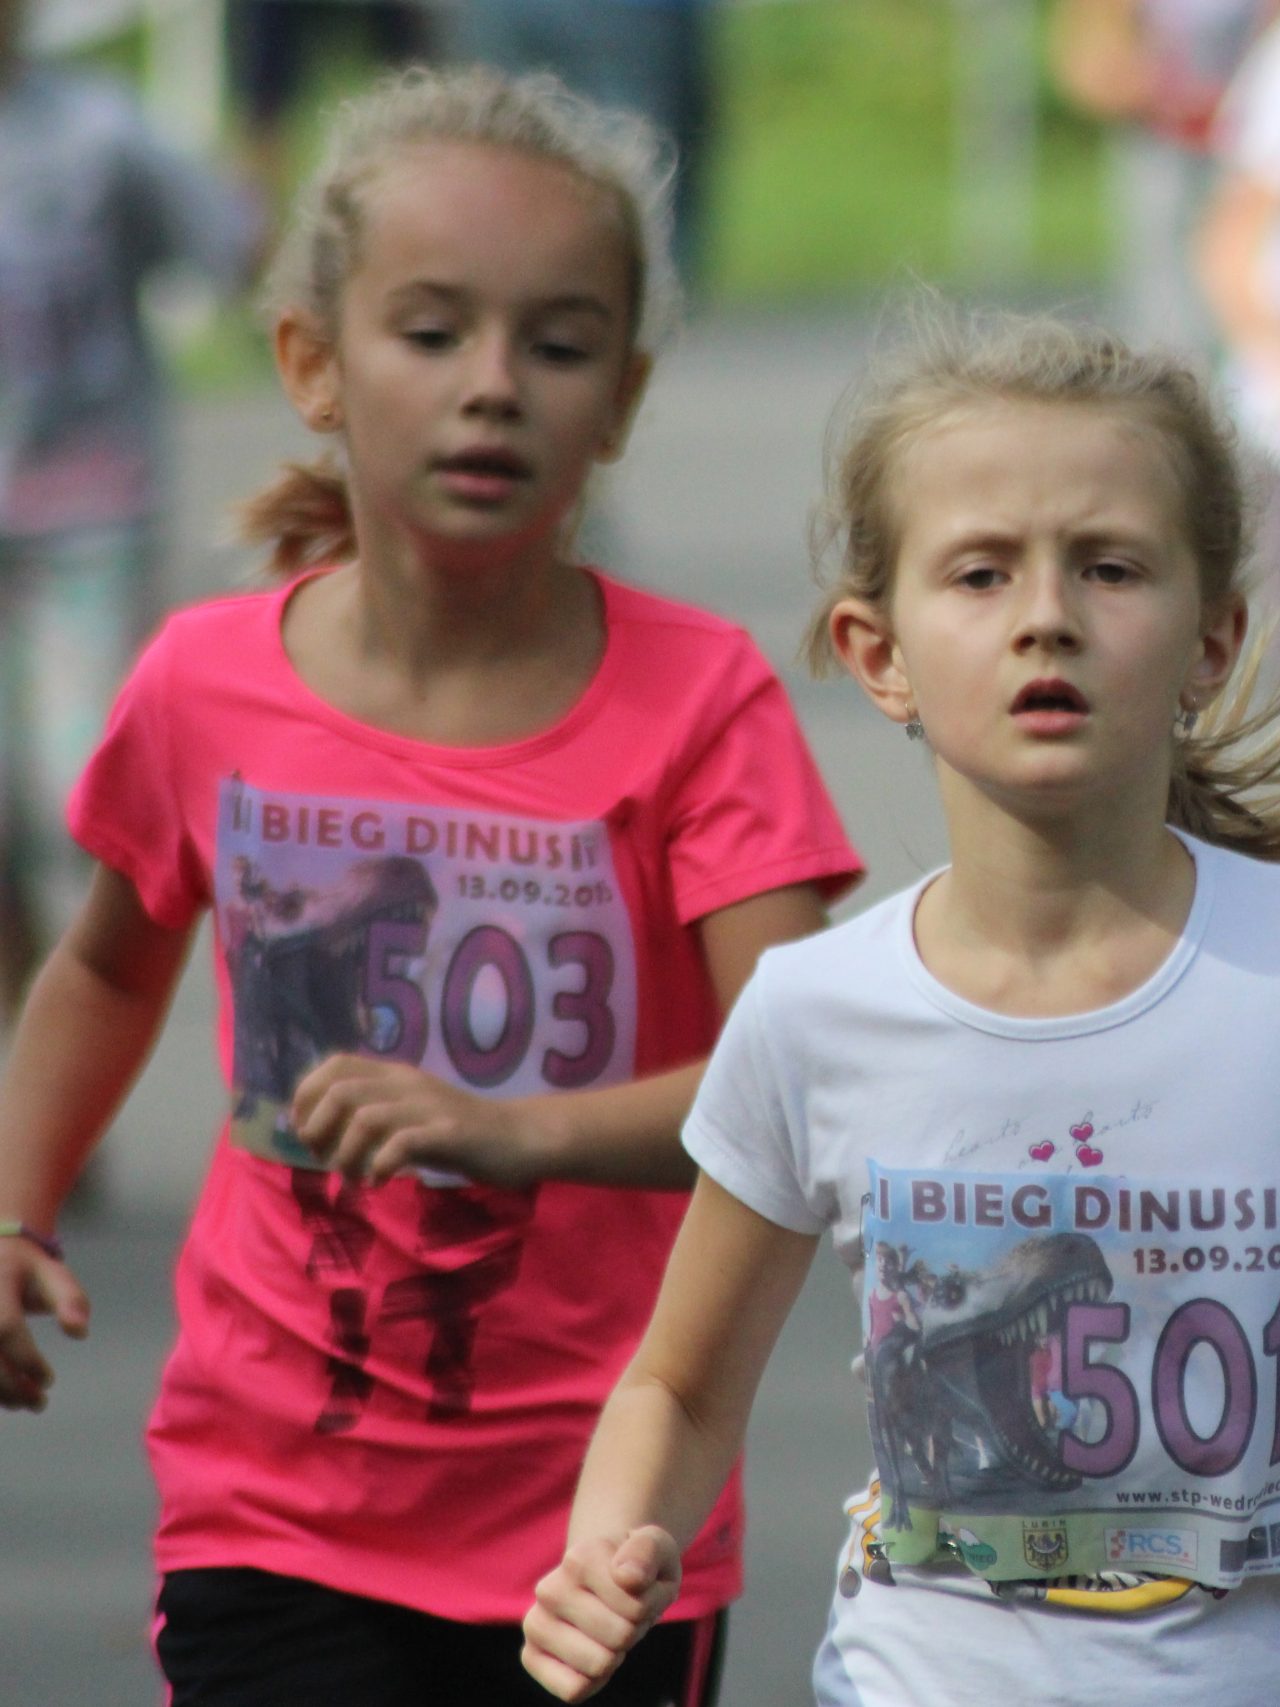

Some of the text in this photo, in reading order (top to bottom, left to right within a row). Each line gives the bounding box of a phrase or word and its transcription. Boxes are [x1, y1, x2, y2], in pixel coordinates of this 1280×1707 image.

[262, 804, 386, 850] BIEG
[362, 920, 617, 1089] 503
[911, 1180, 1052, 1228] BIEG
